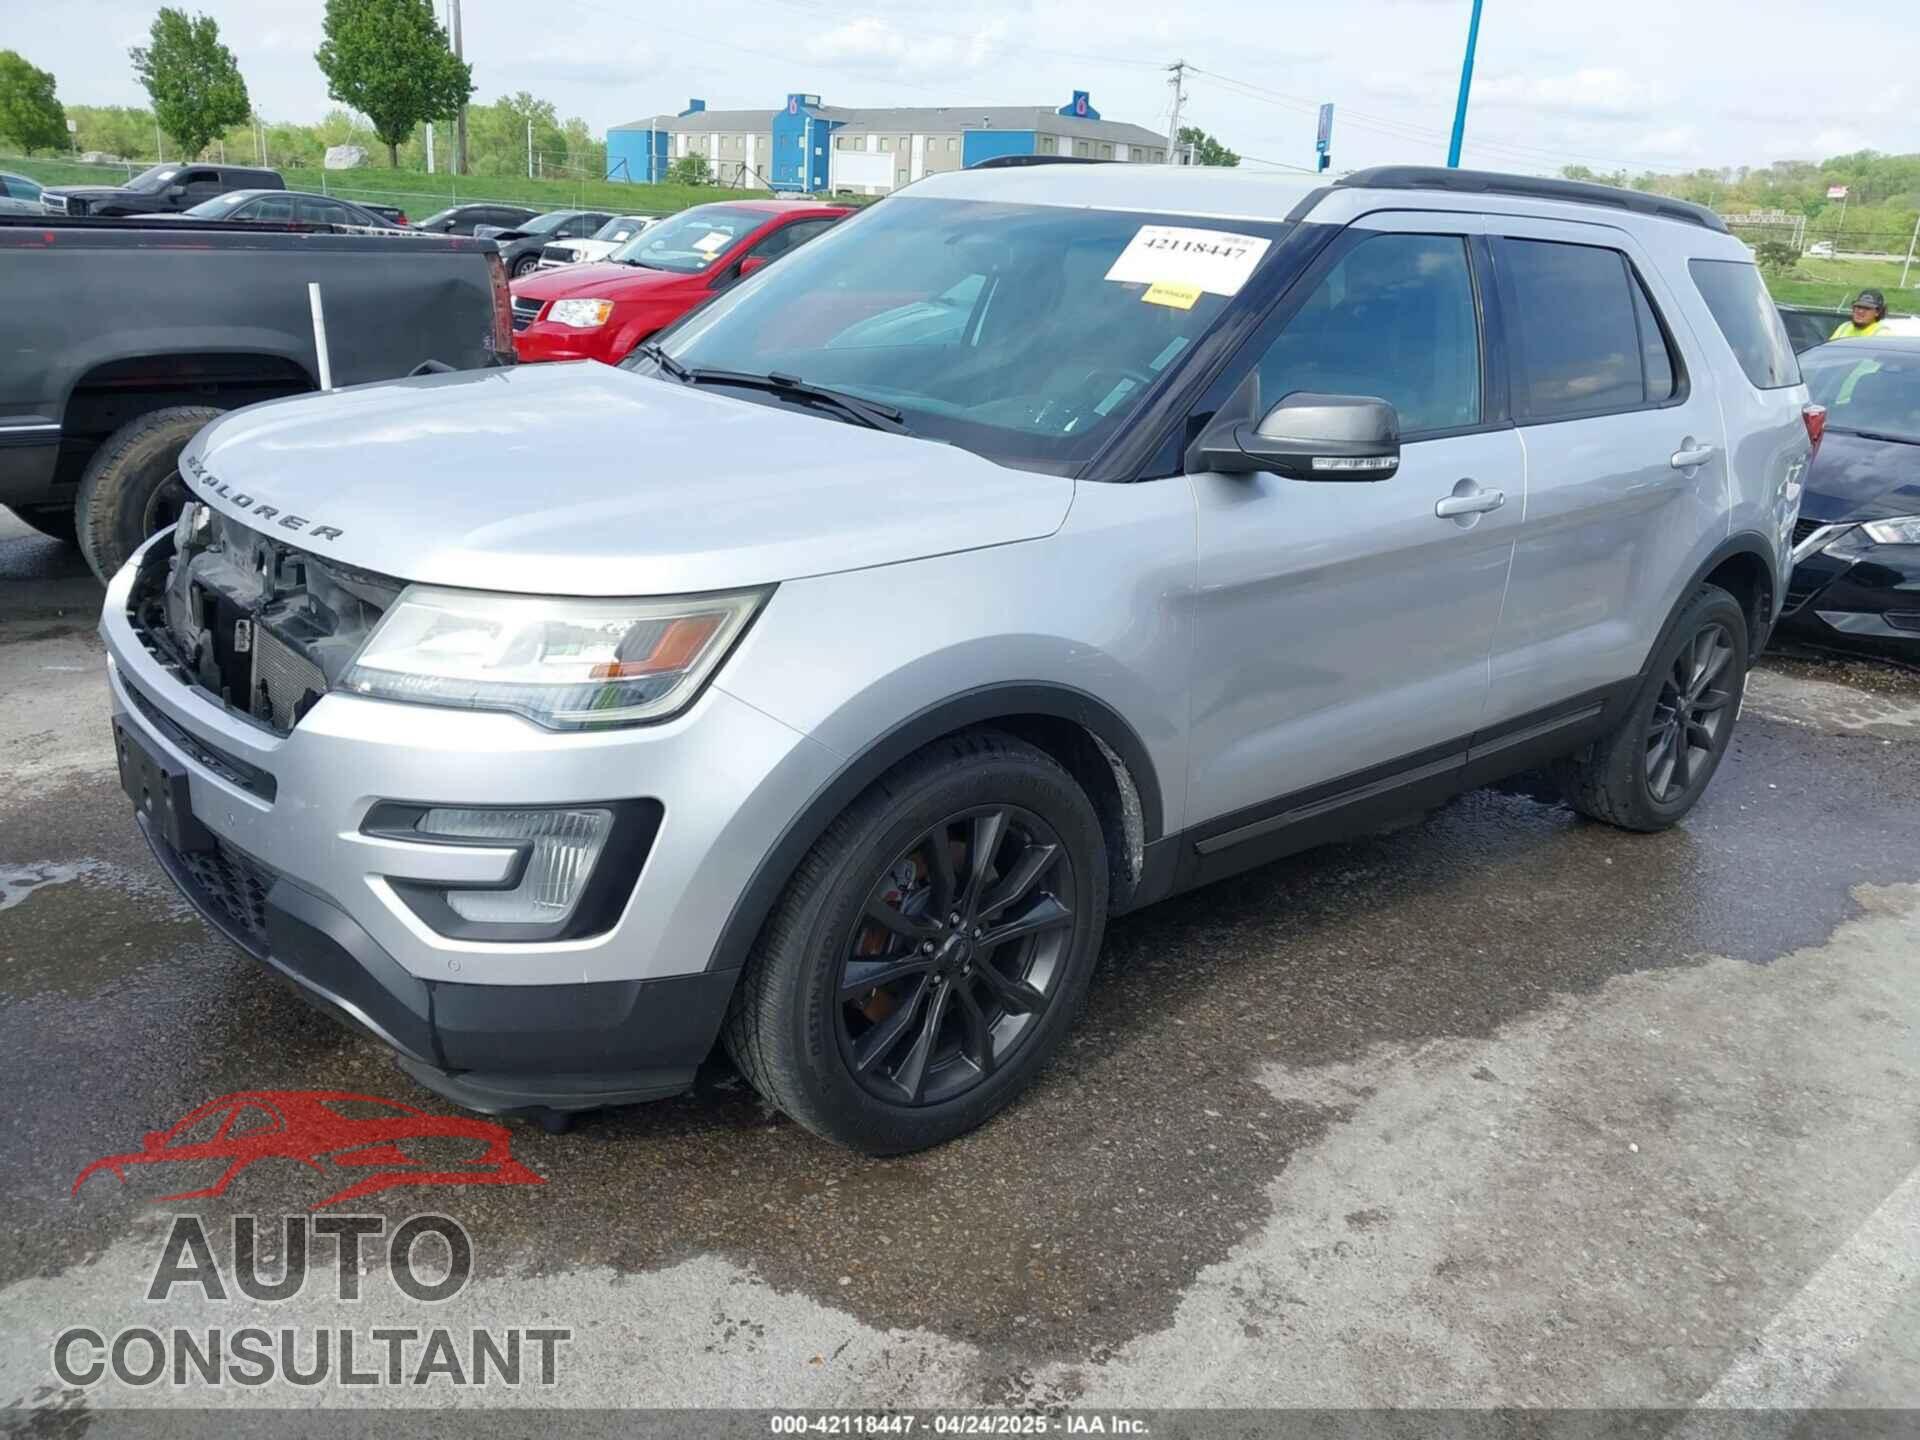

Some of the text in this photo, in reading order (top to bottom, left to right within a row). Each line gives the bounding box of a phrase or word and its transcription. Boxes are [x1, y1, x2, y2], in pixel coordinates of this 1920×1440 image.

[789, 95, 798, 114] 6
[1076, 95, 1087, 115] 6
[1144, 238, 1247, 259] 42118447
[187, 456, 343, 541] EXPLORER
